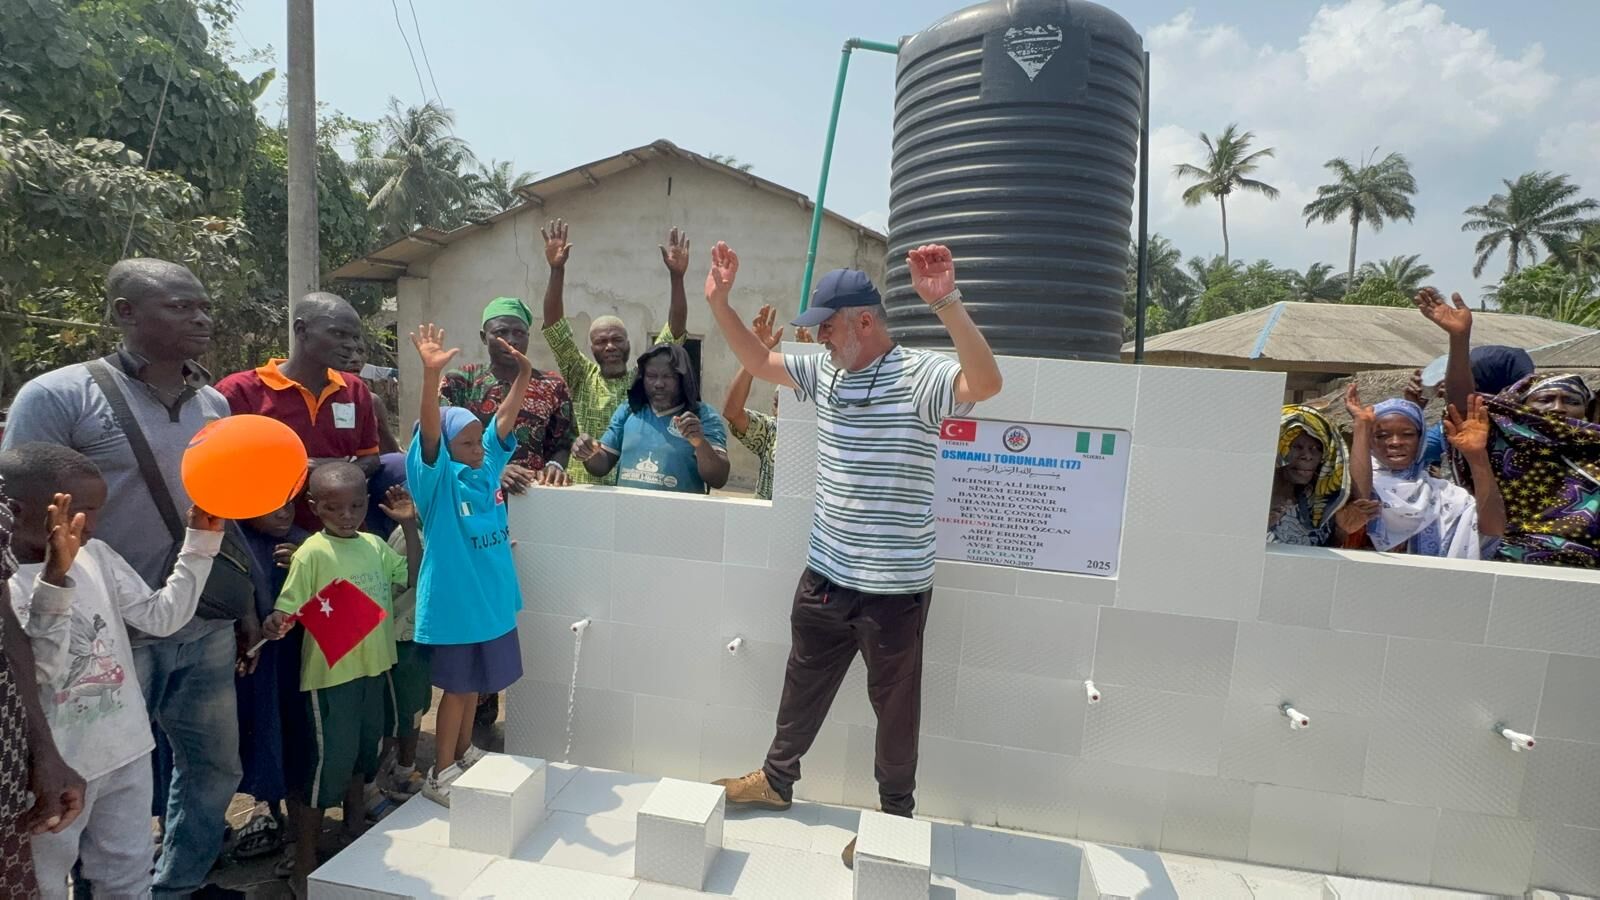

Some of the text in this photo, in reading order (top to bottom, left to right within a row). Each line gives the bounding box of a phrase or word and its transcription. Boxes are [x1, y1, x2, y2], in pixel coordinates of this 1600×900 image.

[941, 449, 991, 463] OSMANLI
[994, 453, 1058, 468] TORUNLARI
[951, 477, 1002, 486] MEHMET
[1025, 483, 1067, 492] ERDEM
[958, 491, 1005, 500] BAYRAM
[1007, 488, 1047, 497] ERDEM
[946, 497, 1016, 508] MUHAMMED
[1007, 516, 1048, 526] ERDEM
[997, 531, 1037, 540] ERDEM
[996, 544, 1037, 554] ERDEM
[1086, 559, 1111, 570] 2025
